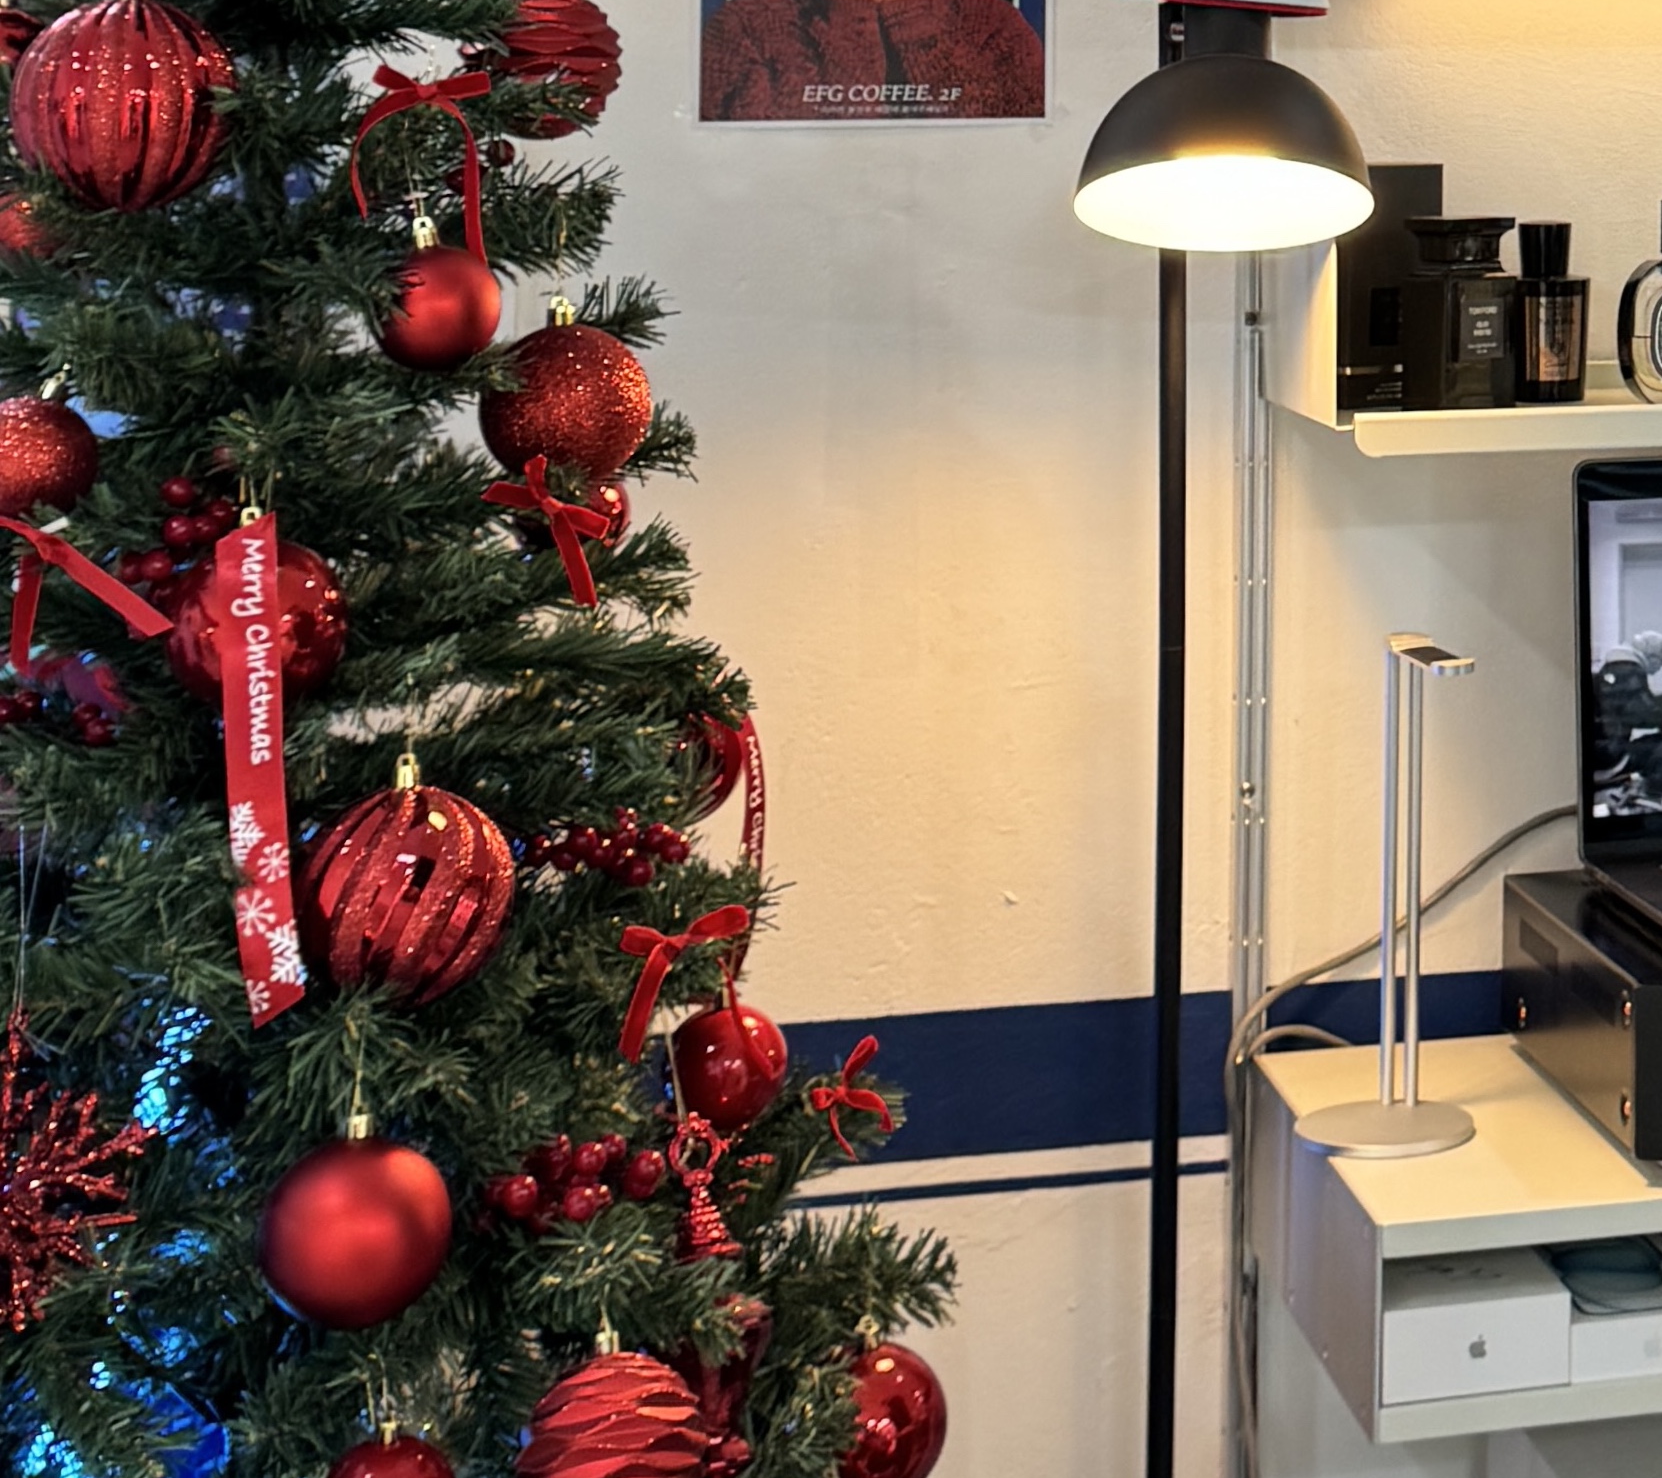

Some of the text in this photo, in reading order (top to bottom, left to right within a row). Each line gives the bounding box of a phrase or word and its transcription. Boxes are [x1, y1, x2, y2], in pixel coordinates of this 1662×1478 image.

[802, 84, 844, 103] EFG
[938, 87, 962, 102] 2F
[231, 537, 275, 766] Merry Christmas
